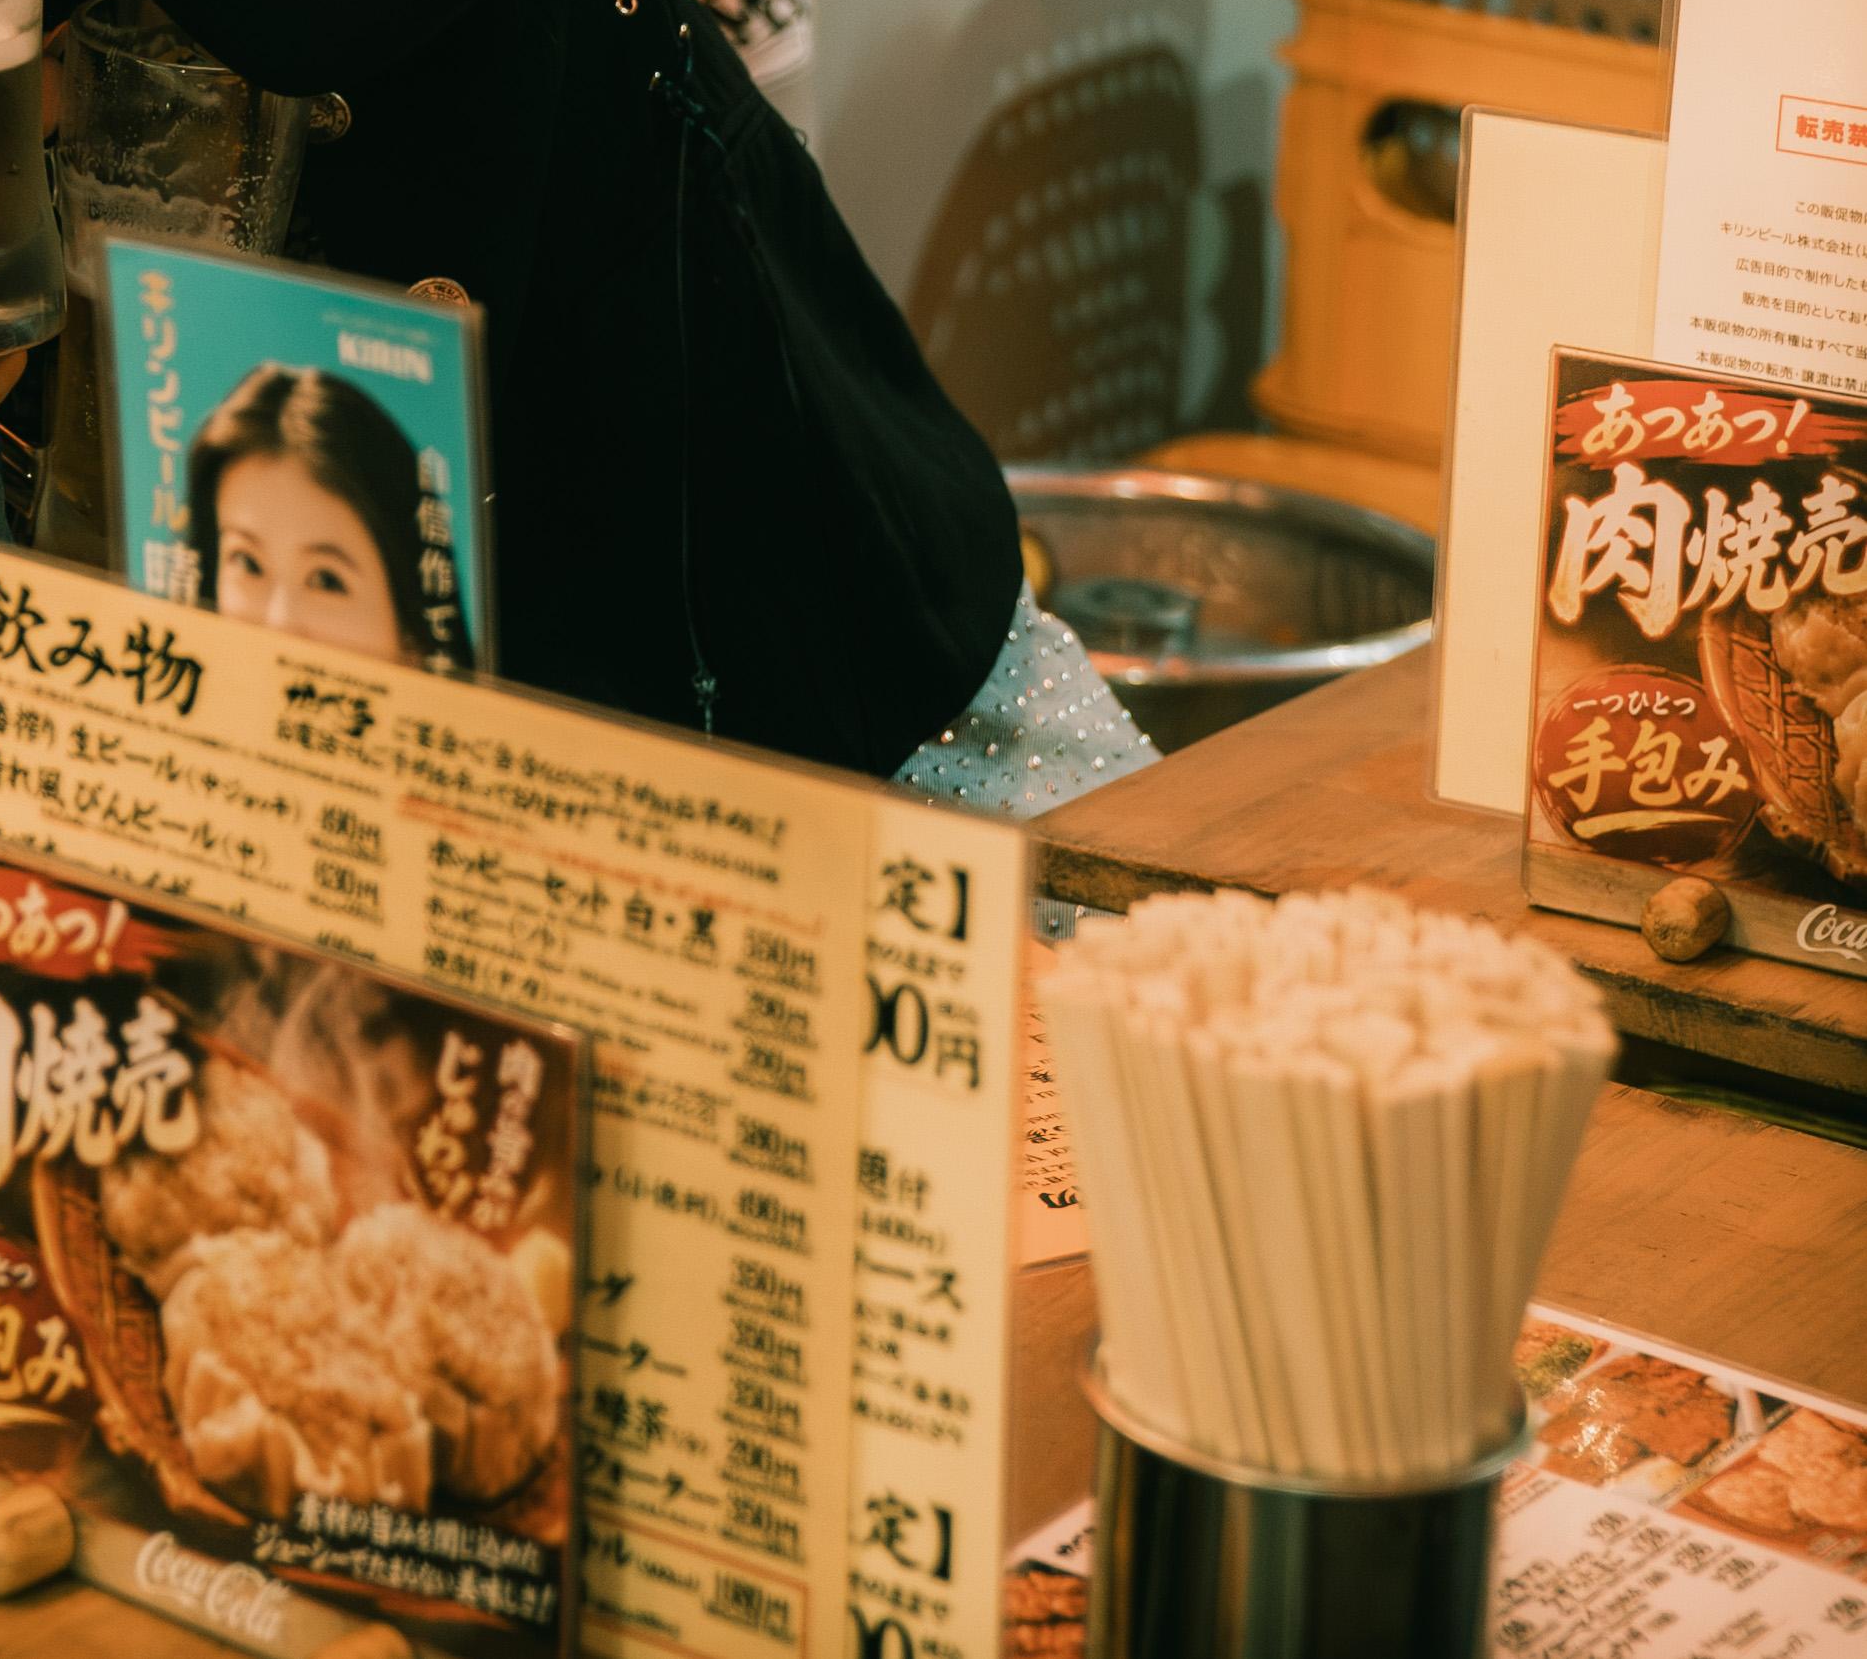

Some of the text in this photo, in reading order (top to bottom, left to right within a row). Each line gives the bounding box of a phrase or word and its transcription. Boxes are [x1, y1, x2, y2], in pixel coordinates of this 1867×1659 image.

[1580, 382, 1809, 456] あつあつ!
[1548, 459, 1867, 641] 肉焼売
[1572, 689, 1697, 717] 一つひとつ
[1547, 718, 1749, 814] 手包み
